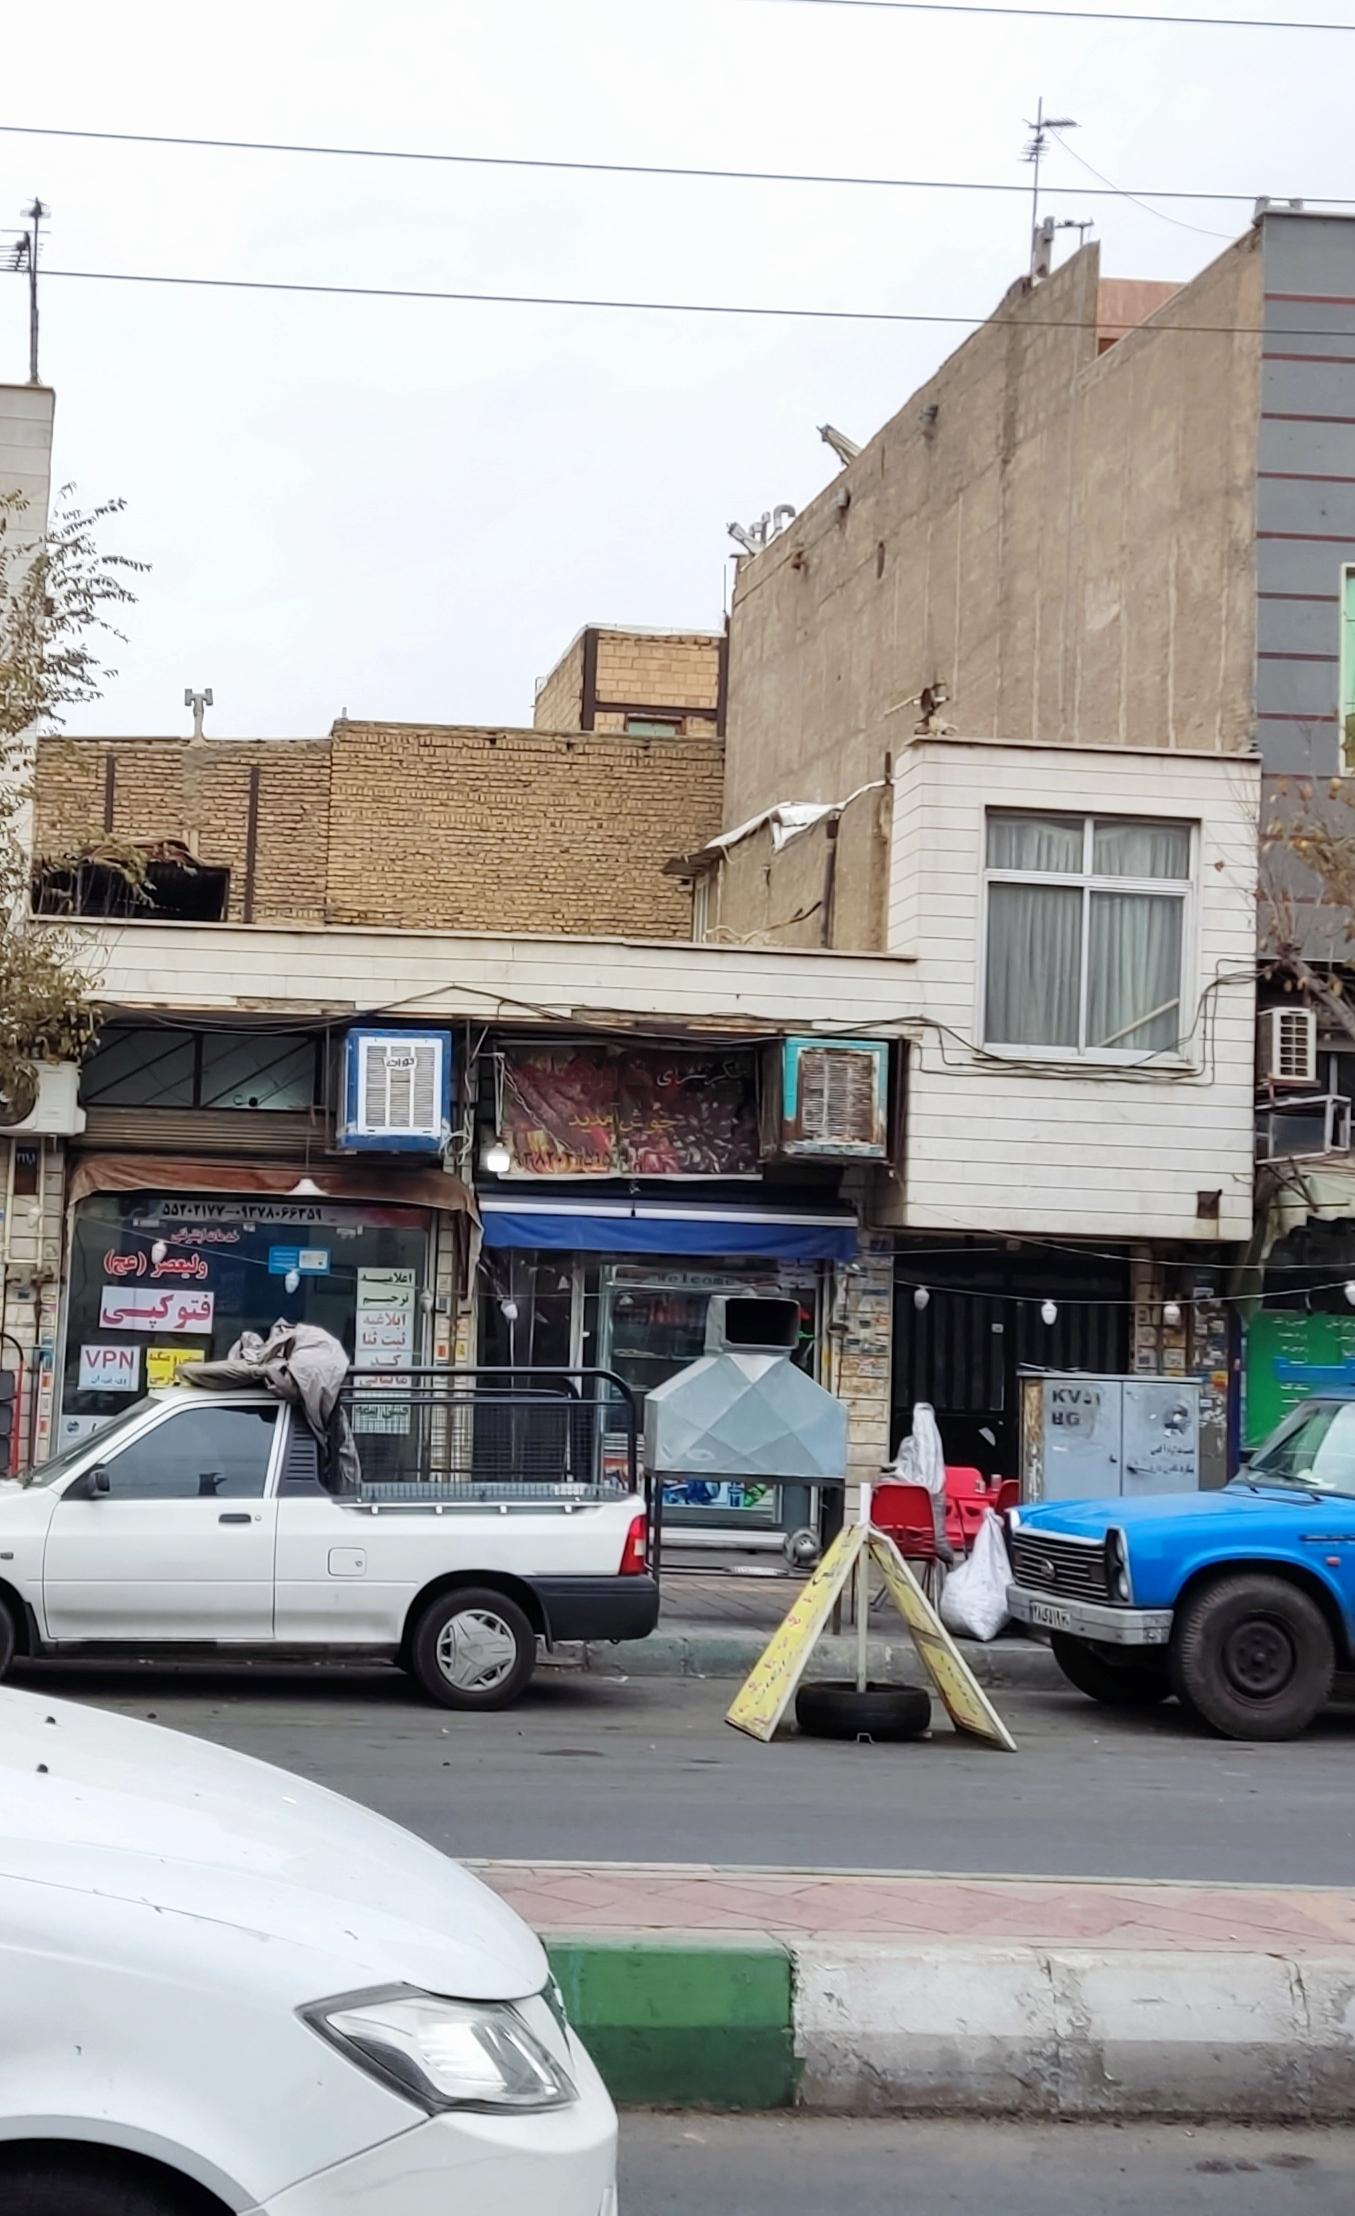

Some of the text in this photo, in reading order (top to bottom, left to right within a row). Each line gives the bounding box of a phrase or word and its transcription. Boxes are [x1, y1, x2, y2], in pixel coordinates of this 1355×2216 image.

[363, 1312, 406, 1330] ابلاغیه
[86, 1350, 134, 1370] VPN
[371, 1354, 401, 1366] کد
